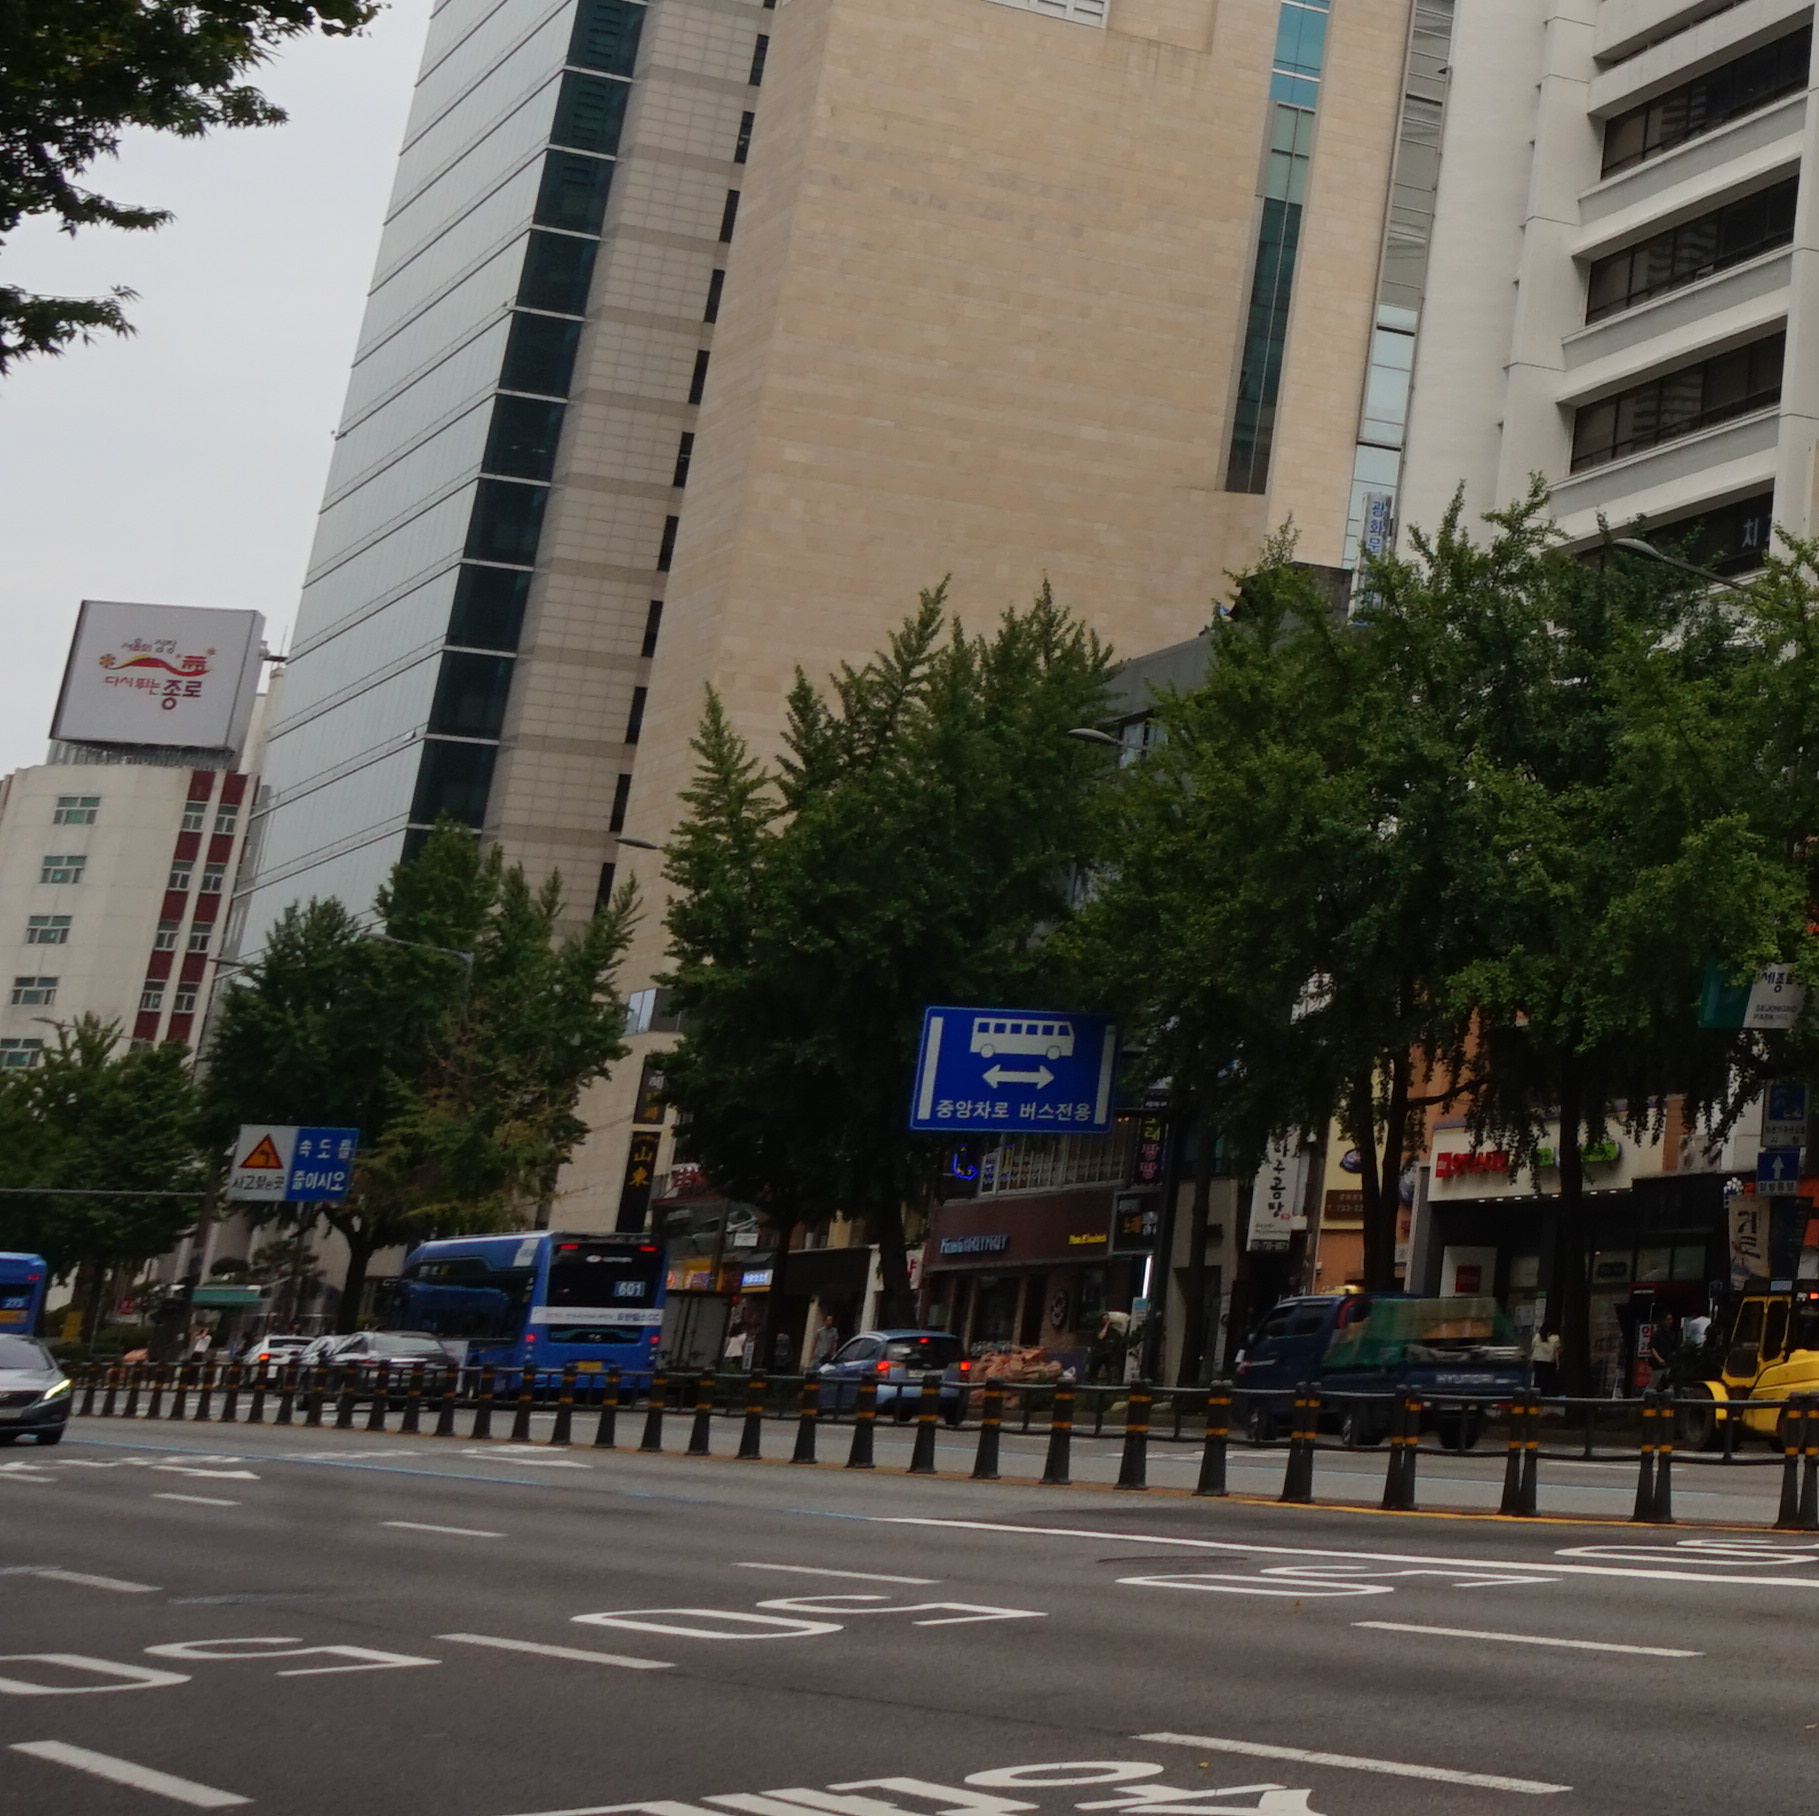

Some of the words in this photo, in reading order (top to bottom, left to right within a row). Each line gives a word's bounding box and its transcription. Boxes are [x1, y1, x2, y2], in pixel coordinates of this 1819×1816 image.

[161, 679, 203, 711] 종로
[935, 1099, 1010, 1119] 중앙차로
[1019, 1101, 1092, 1122] 버스전용
[617, 1282, 643, 1297] 601
